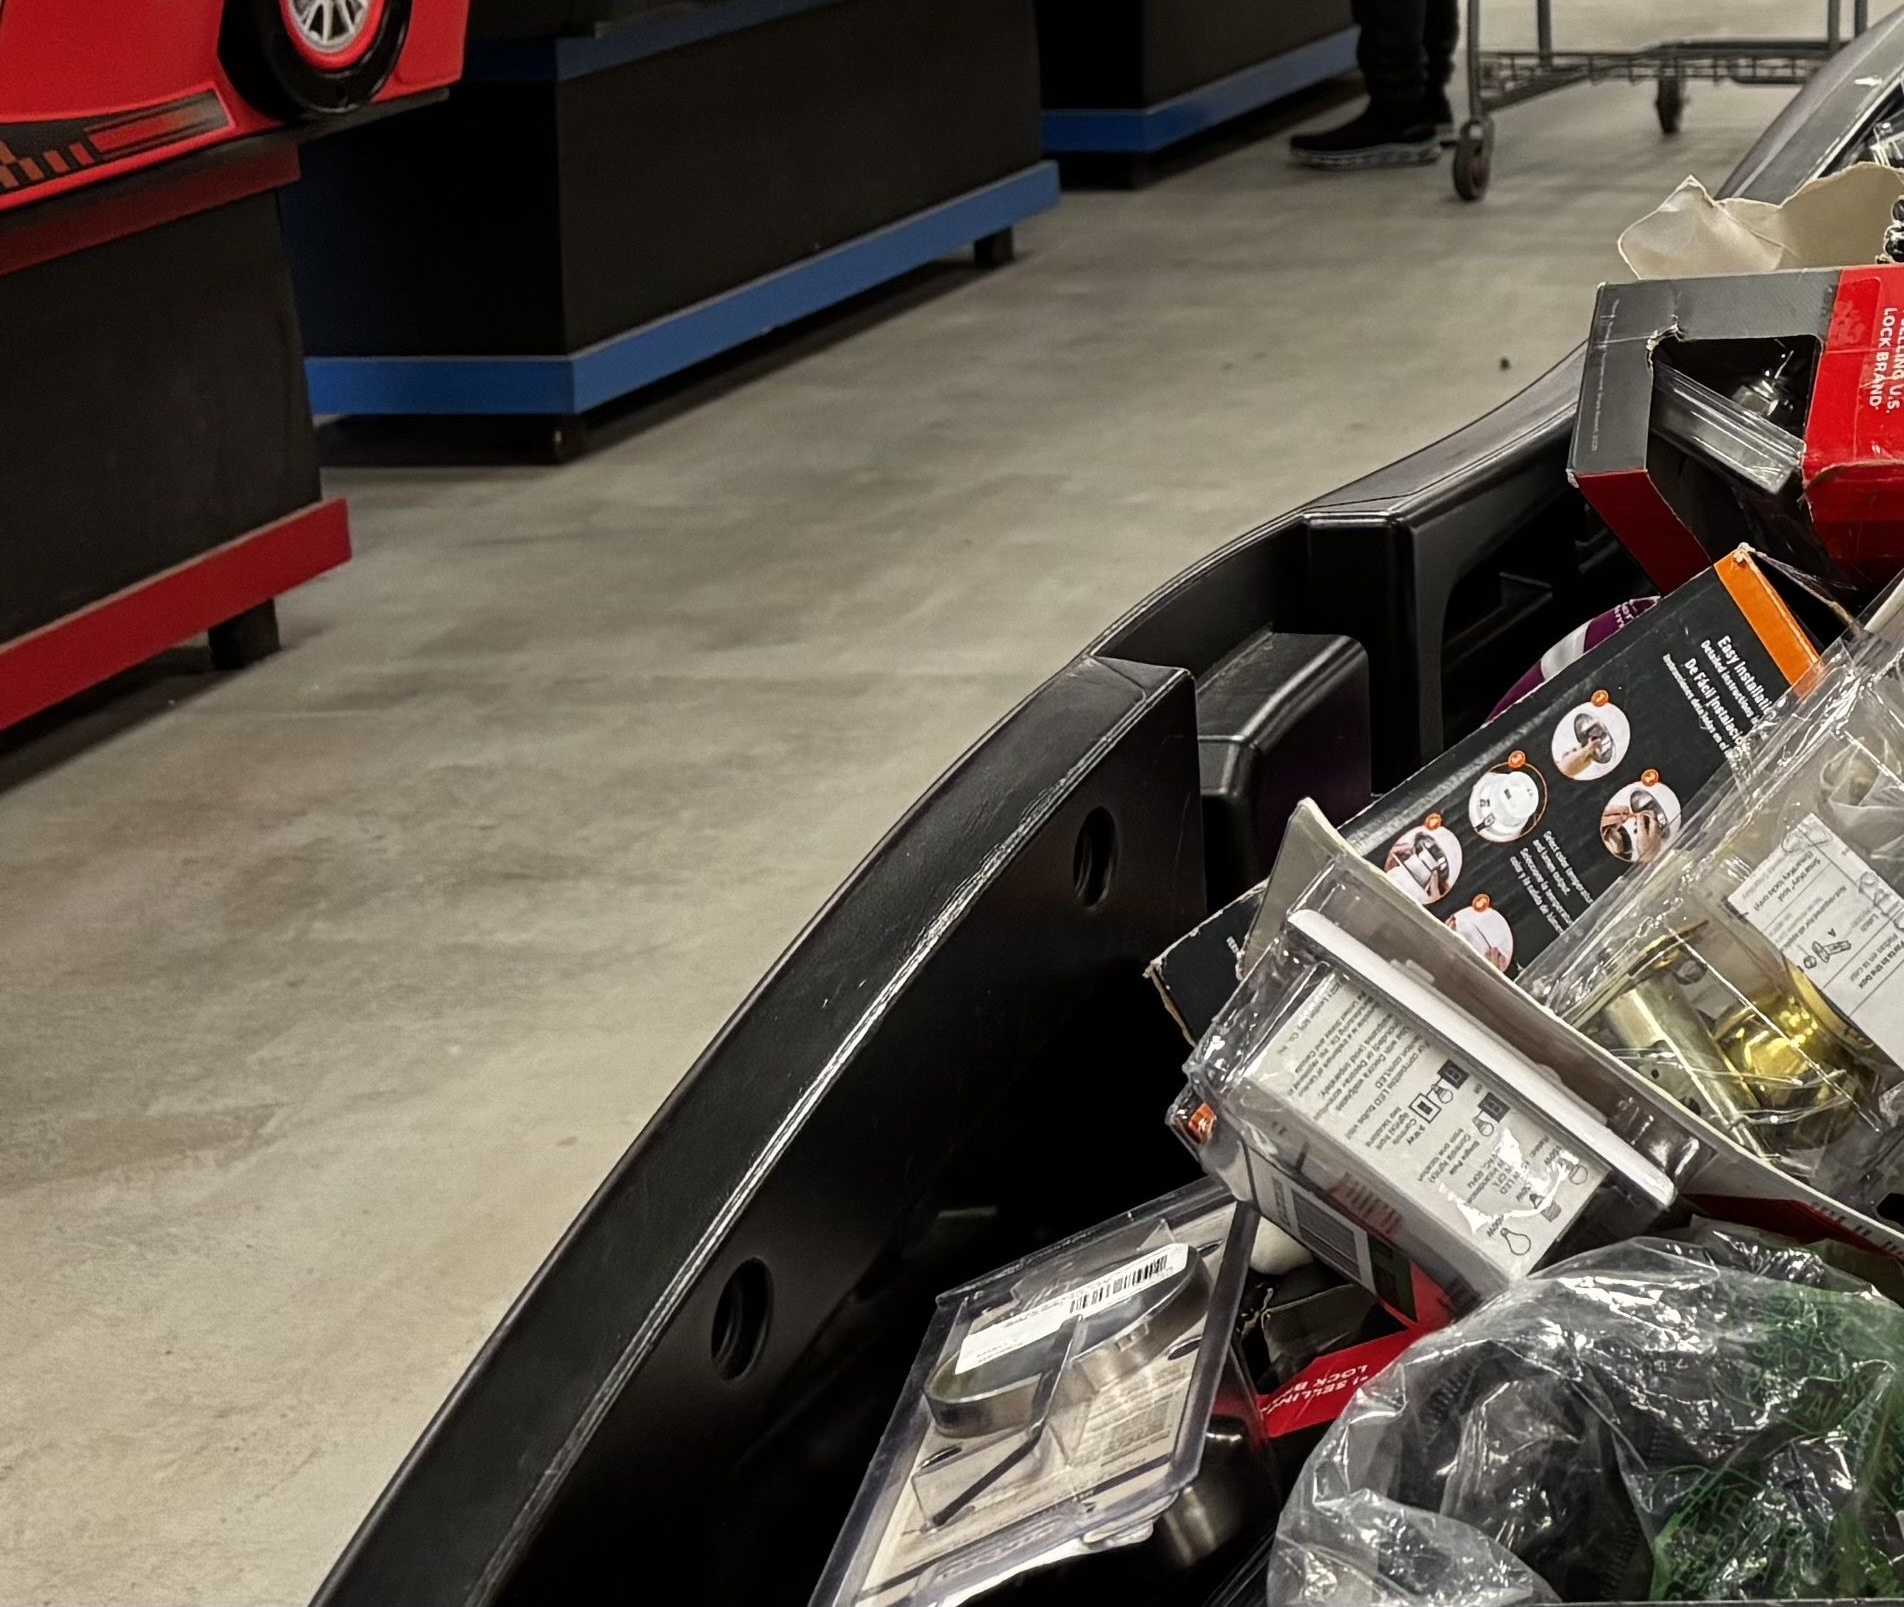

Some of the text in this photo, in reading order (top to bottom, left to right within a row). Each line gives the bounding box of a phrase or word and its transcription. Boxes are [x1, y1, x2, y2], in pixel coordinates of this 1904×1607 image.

[1869, 307, 1897, 410] LOCK BRAND
[1886, 387, 1903, 413] U.S.
[1717, 635, 1740, 665] Easy
[1684, 658, 1717, 699] De Fácil
[1700, 639, 1755, 718] Detailed instructions
[1533, 840, 1545, 852] and
[1541, 851, 1556, 873] lumen
[1544, 831, 1569, 868] Select color
[1766, 879, 1783, 895] locks
[1827, 928, 1836, 937] A
[1857, 974, 1871, 988] box
[1870, 964, 1882, 976] the
